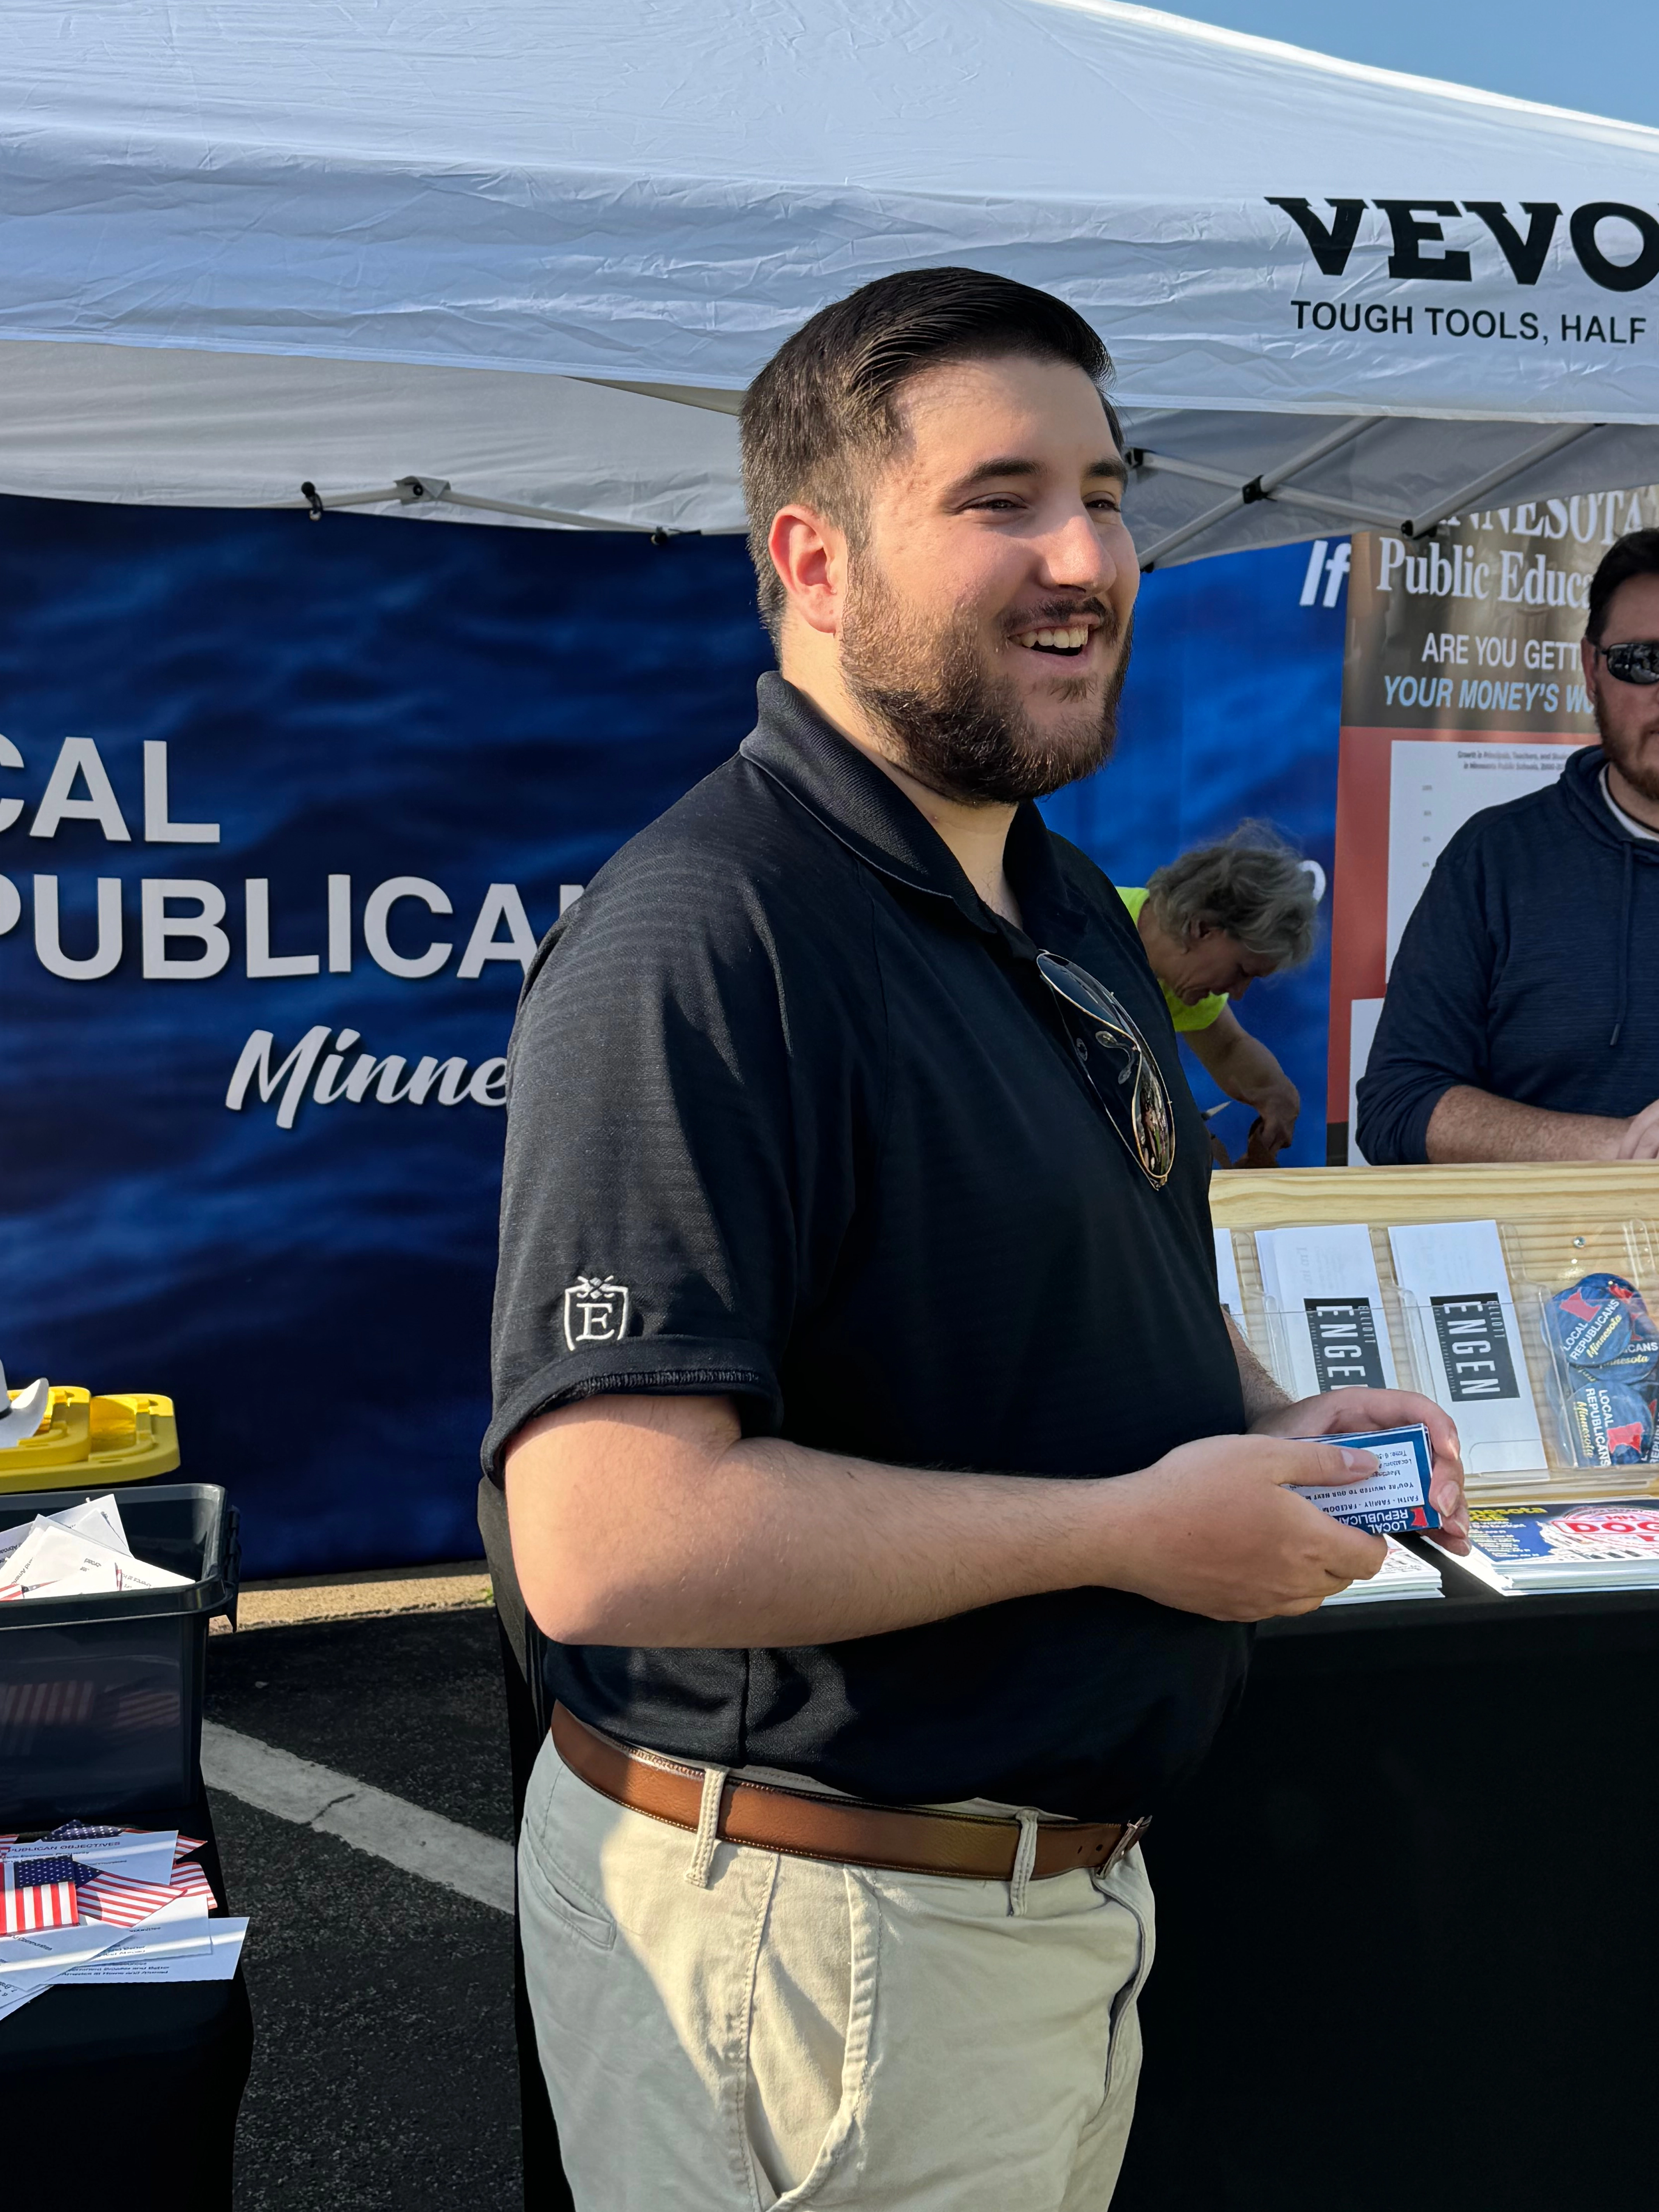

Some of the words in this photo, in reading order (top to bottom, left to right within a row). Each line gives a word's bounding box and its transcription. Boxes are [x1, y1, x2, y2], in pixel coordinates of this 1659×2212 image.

[1264, 197, 1659, 292] VEVO
[1291, 301, 1413, 334] TOUGH
[1425, 307, 1548, 345] TOOLS,
[1561, 314, 1646, 344] HALF
[1376, 536, 1490, 600] Public
[1421, 632, 1470, 664] ARE
[1475, 636, 1517, 668] YOU
[1384, 675, 1453, 708] YOUR
[1458, 680, 1560, 713] MONEY'S
[0, 733, 220, 843] AL
[0, 874, 585, 980] UBLICA
[225, 1025, 508, 1128] Minne
[575, 1303, 615, 1341] E
[1358, 1306, 1376, 1343] ELLIOTT
[1487, 1300, 1505, 1338] ELLIOTT
[1563, 1322, 1588, 1351] LOCAL
[1570, 1299, 1620, 1360] REPUBLICANS
[1586, 1314, 1622, 1358] Minnesota
[1443, 1301, 1501, 1394] ENGEN
[1574, 1401, 1594, 1458] Minnesota
[1585, 1388, 1612, 1467] REPUBLICANS
[1599, 1389, 1614, 1427] LOCAL
[1367, 1520, 1407, 1534] LOCAL
